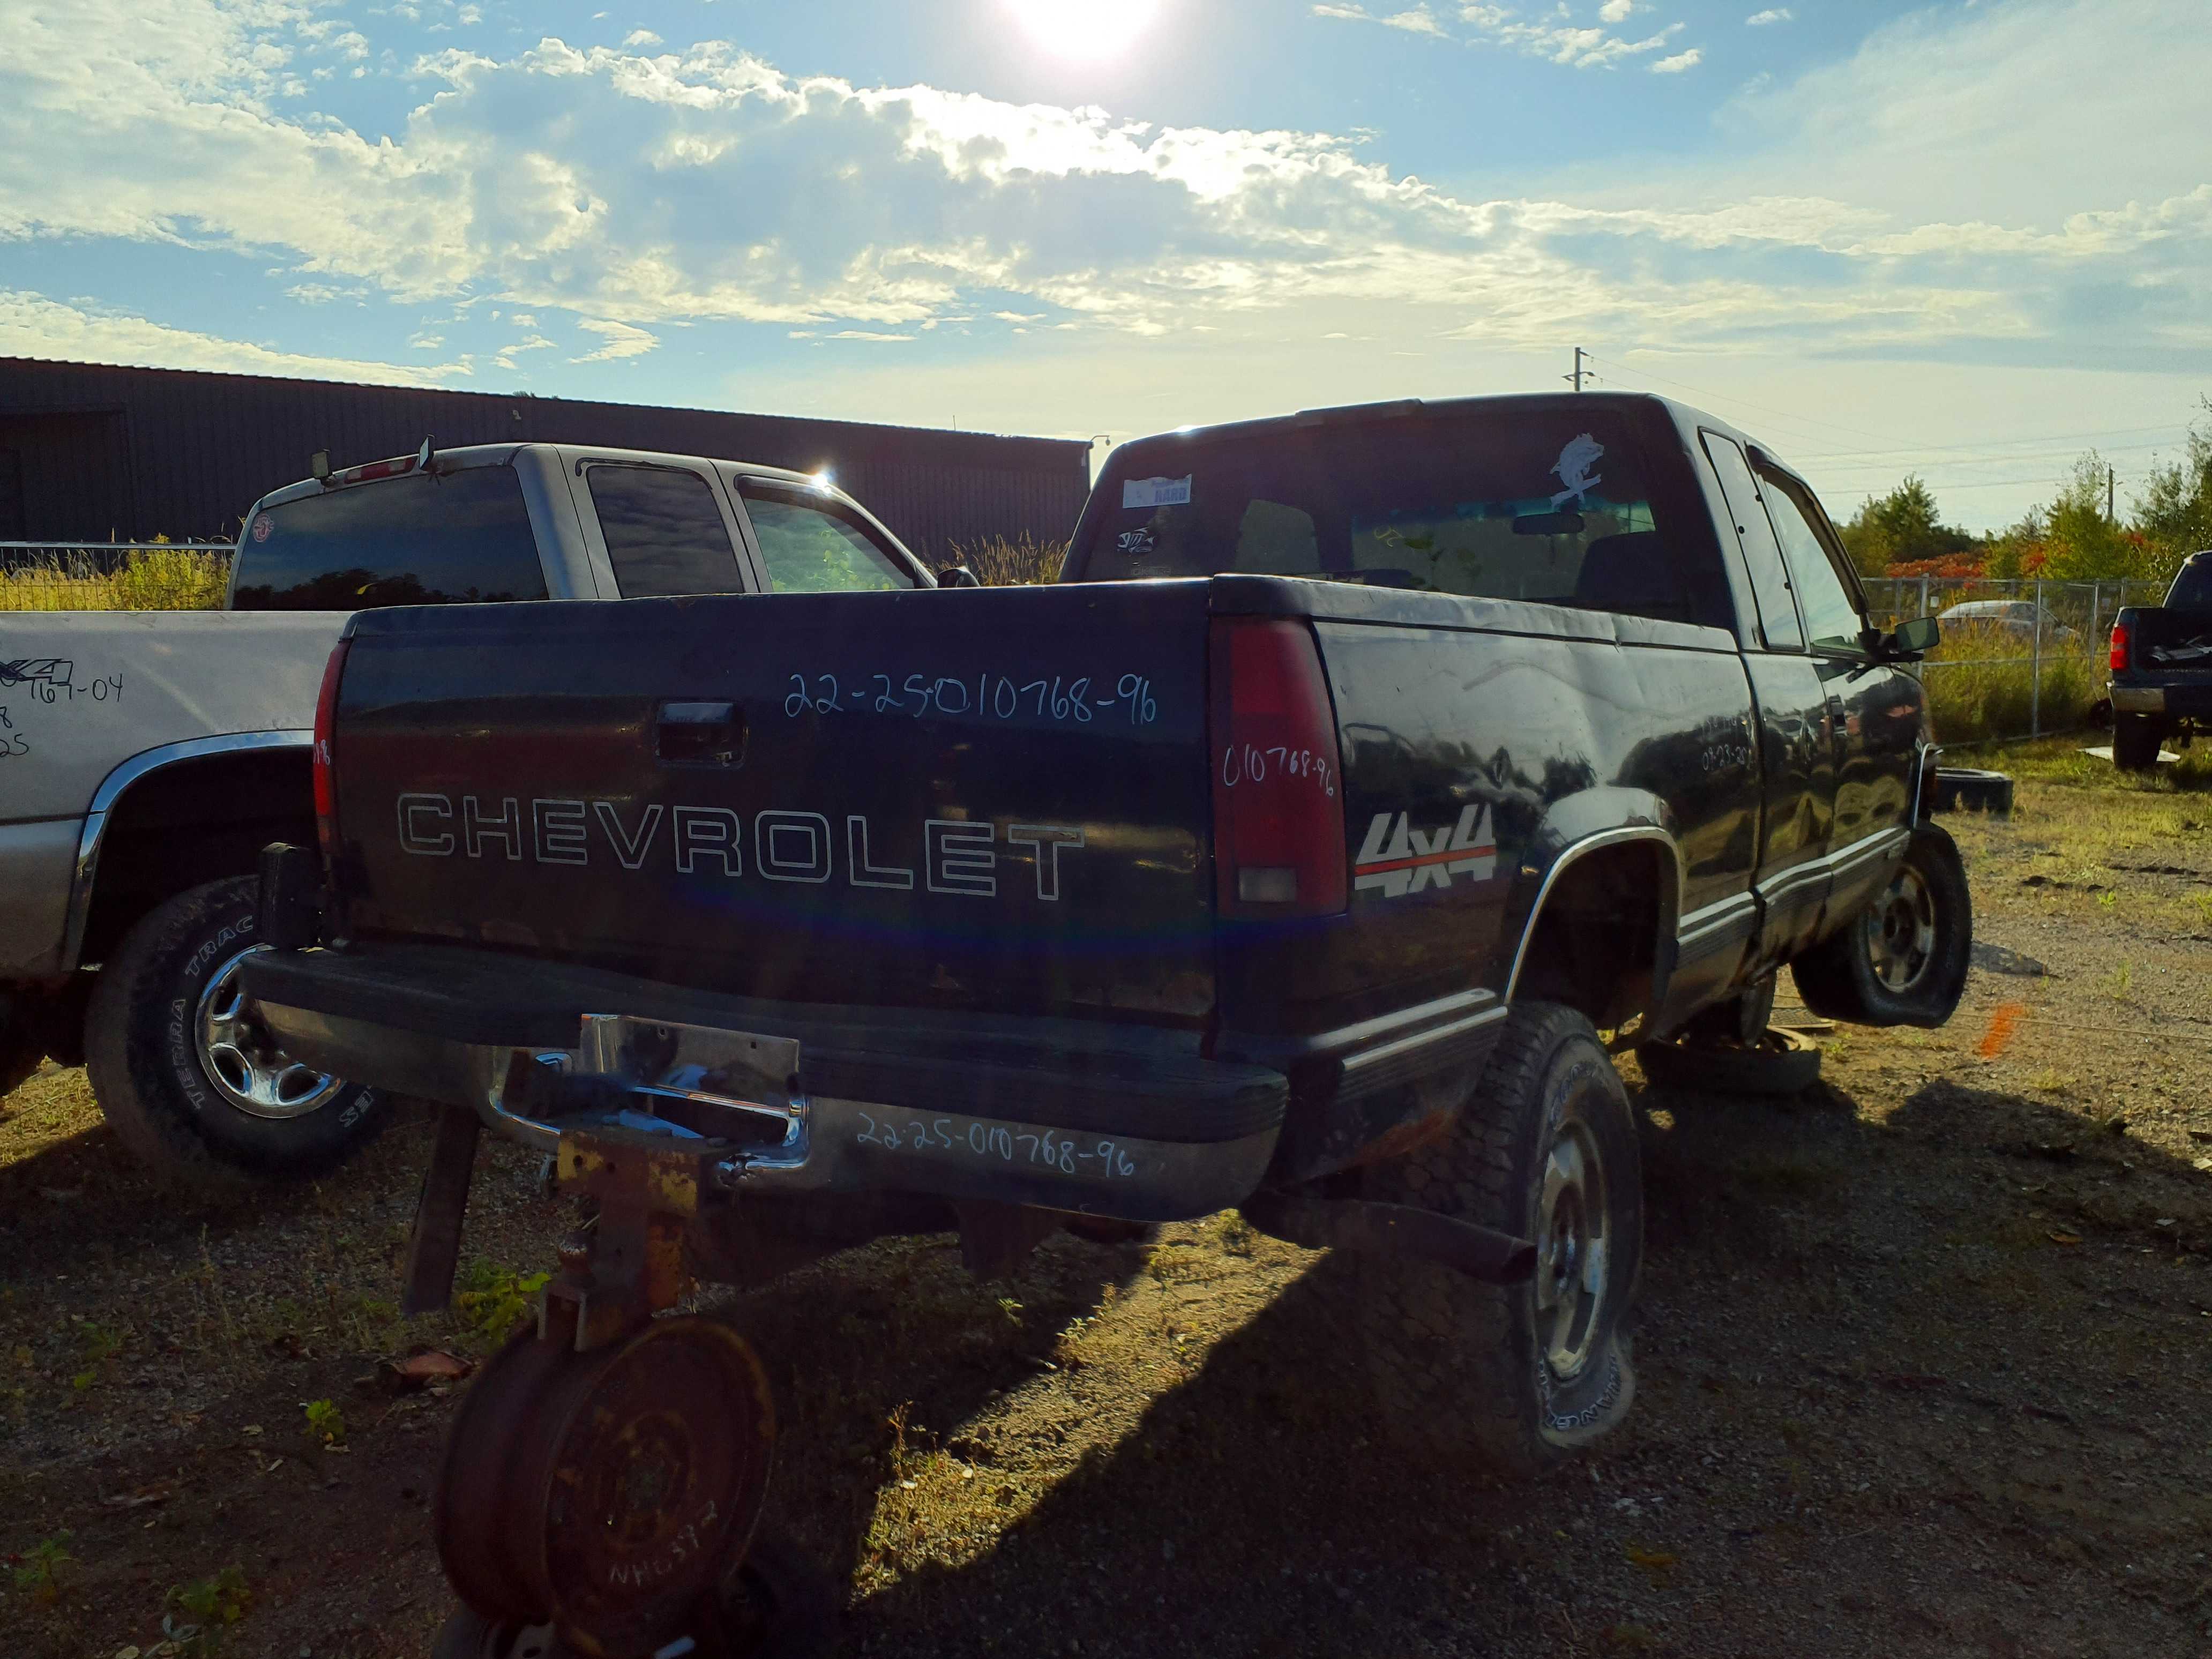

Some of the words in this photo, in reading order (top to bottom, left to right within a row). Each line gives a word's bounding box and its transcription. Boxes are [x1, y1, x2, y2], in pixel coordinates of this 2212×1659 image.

[397, 792, 1086, 901] CHEVROLET
[184, 915, 255, 978] TRAC
[167, 998, 206, 1111] TERRA
